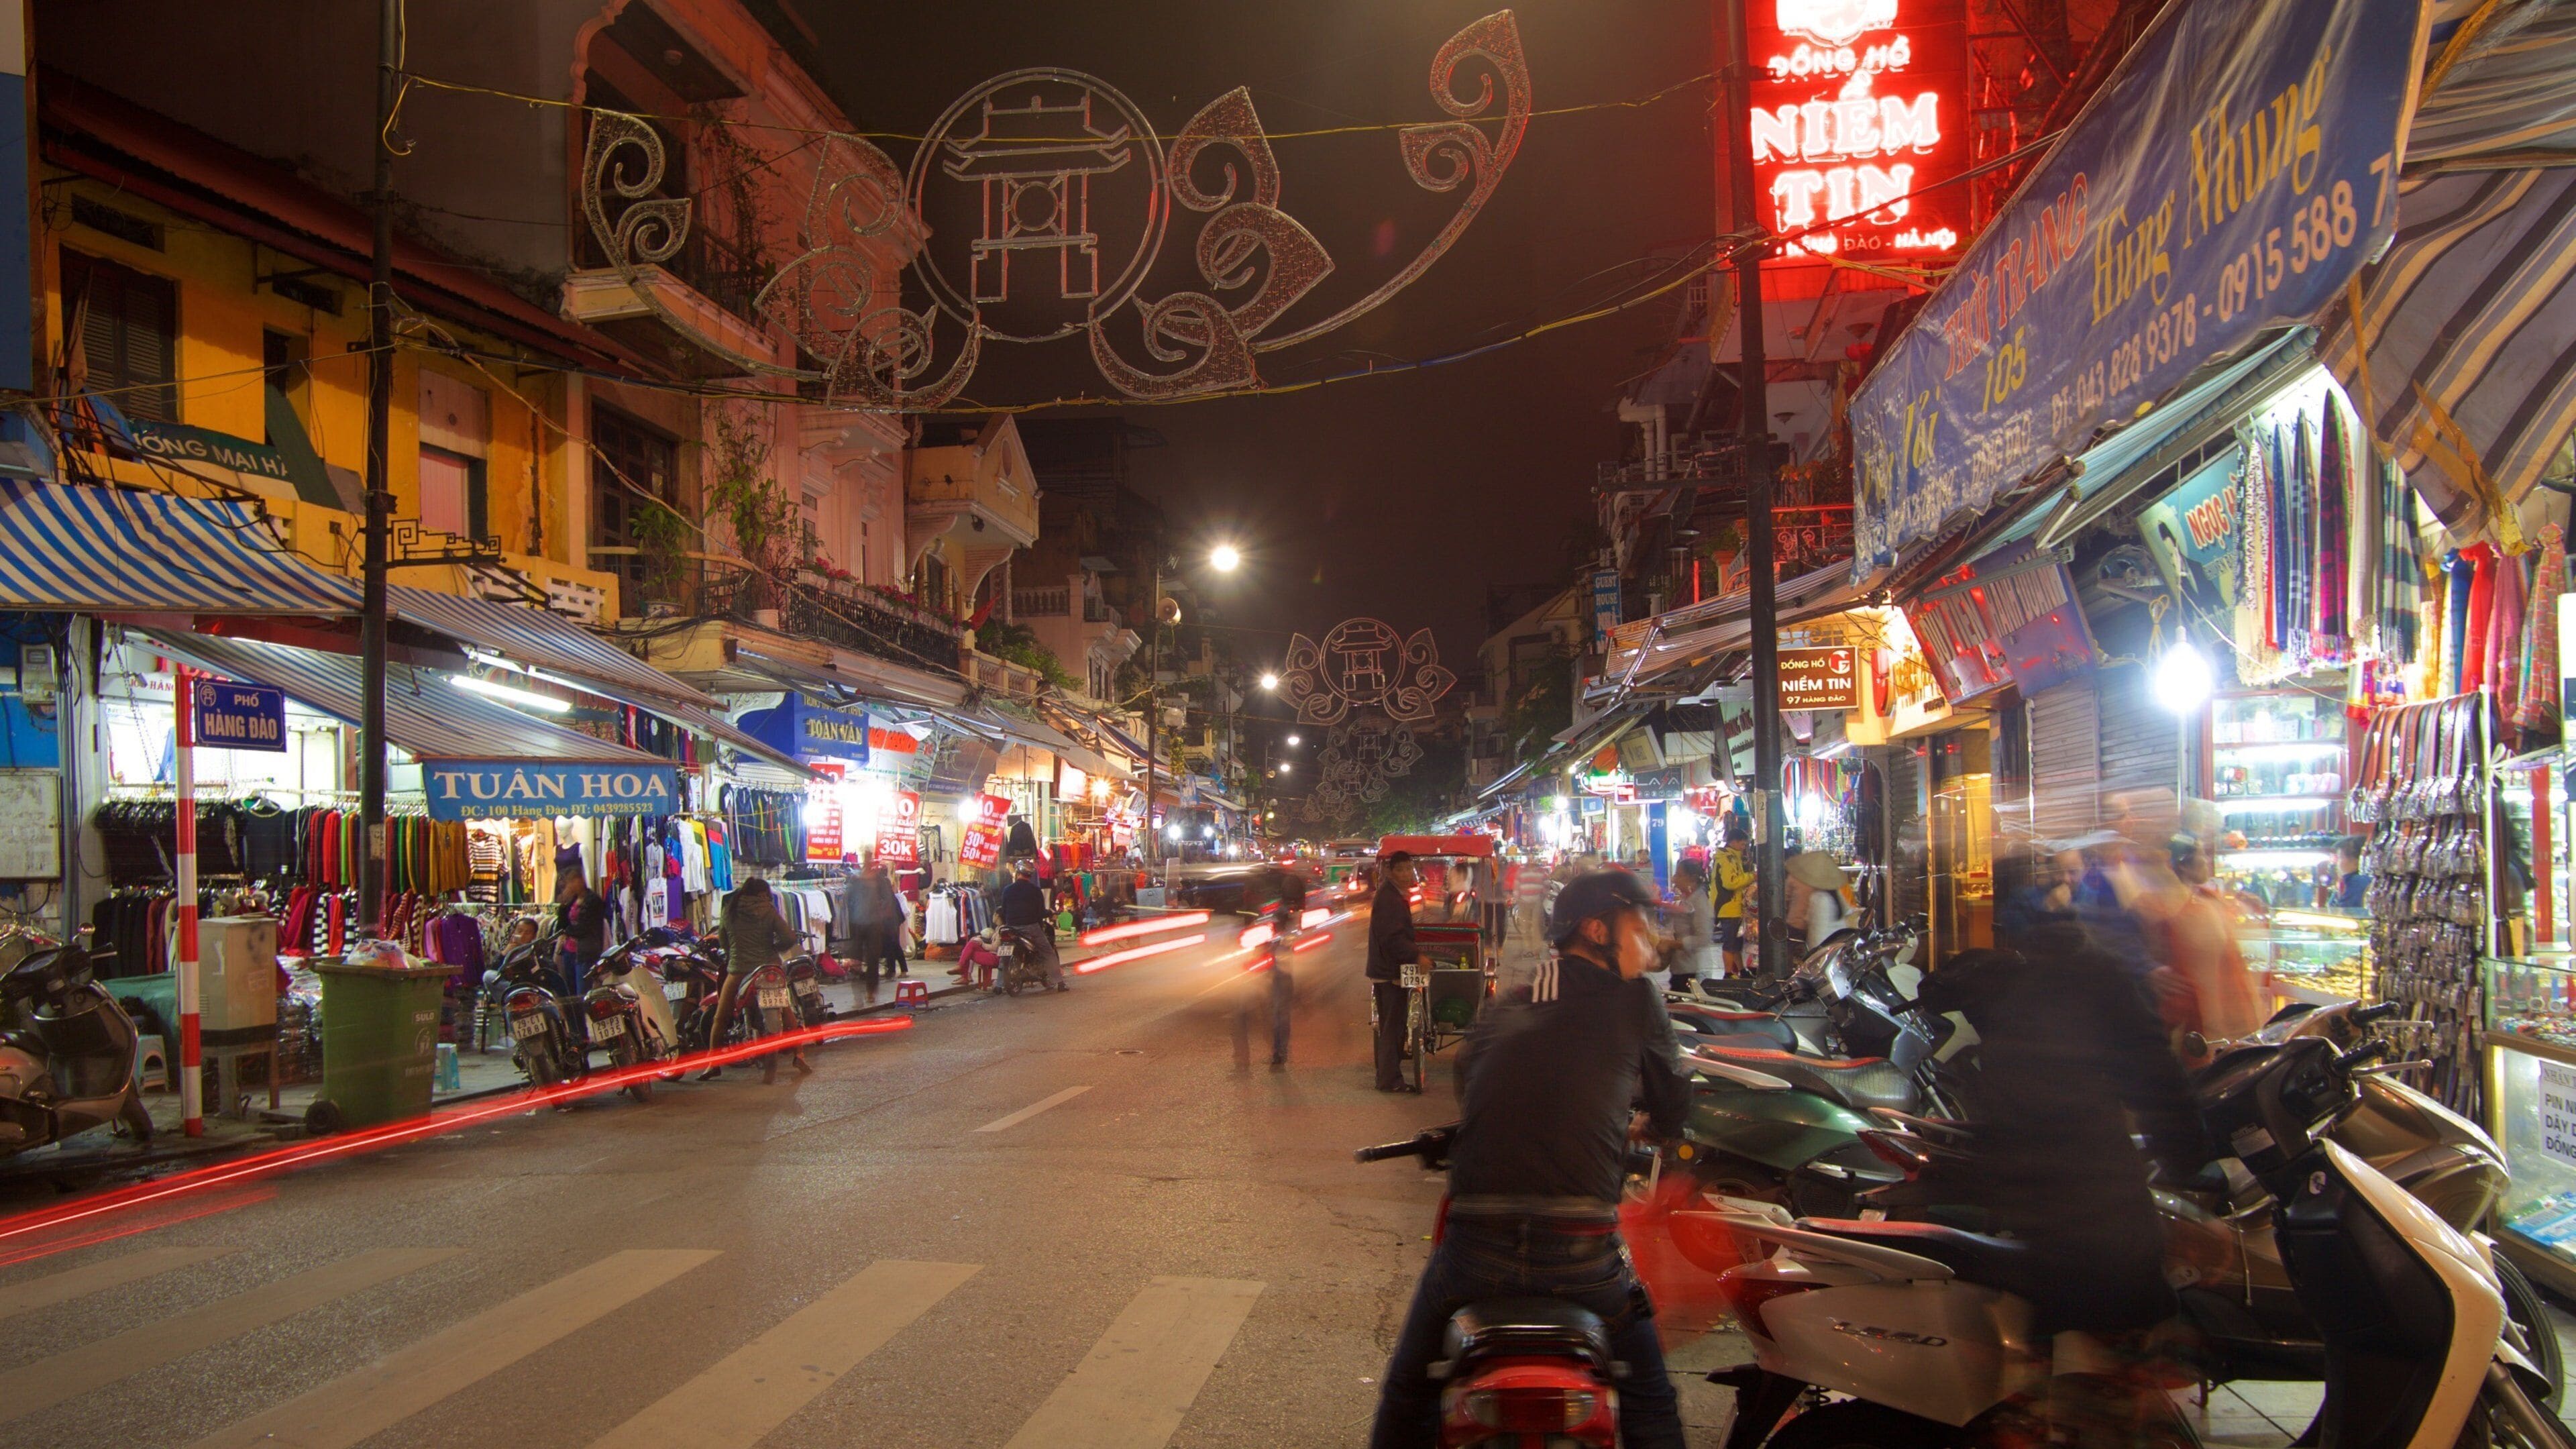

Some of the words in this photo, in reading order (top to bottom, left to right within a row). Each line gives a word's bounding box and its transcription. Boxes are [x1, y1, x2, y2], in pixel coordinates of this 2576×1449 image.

[1774, 164, 1915, 224] TIN
[1995, 172, 2088, 331] TRANG
[2109, 333, 2141, 397] 828
[2147, 292, 2196, 372] 9378
[2218, 227, 2284, 322] 0915
[2291, 180, 2357, 274] 588
[1982, 326, 2027, 414] 105
[2184, 494, 2231, 549] NGỌC
[1596, 593, 1618, 606] HOUSE
[1826, 678, 1851, 690] TIN
[233, 692, 260, 707] PHỐ
[1786, 696, 1801, 704] 97
[204, 708, 246, 737] HÀNG
[249, 712, 278, 740] ĐÀO
[579, 773, 668, 798] HOA
[488, 805, 508, 816] 100
[571, 804, 591, 815] ĐT:
[593, 802, 653, 814] 0439285523
[1652, 818, 1664, 828] 79
[879, 839, 912, 855] 30k
[416, 1012, 435, 1021] SULO
[2545, 1093, 2563, 1110] PIN
